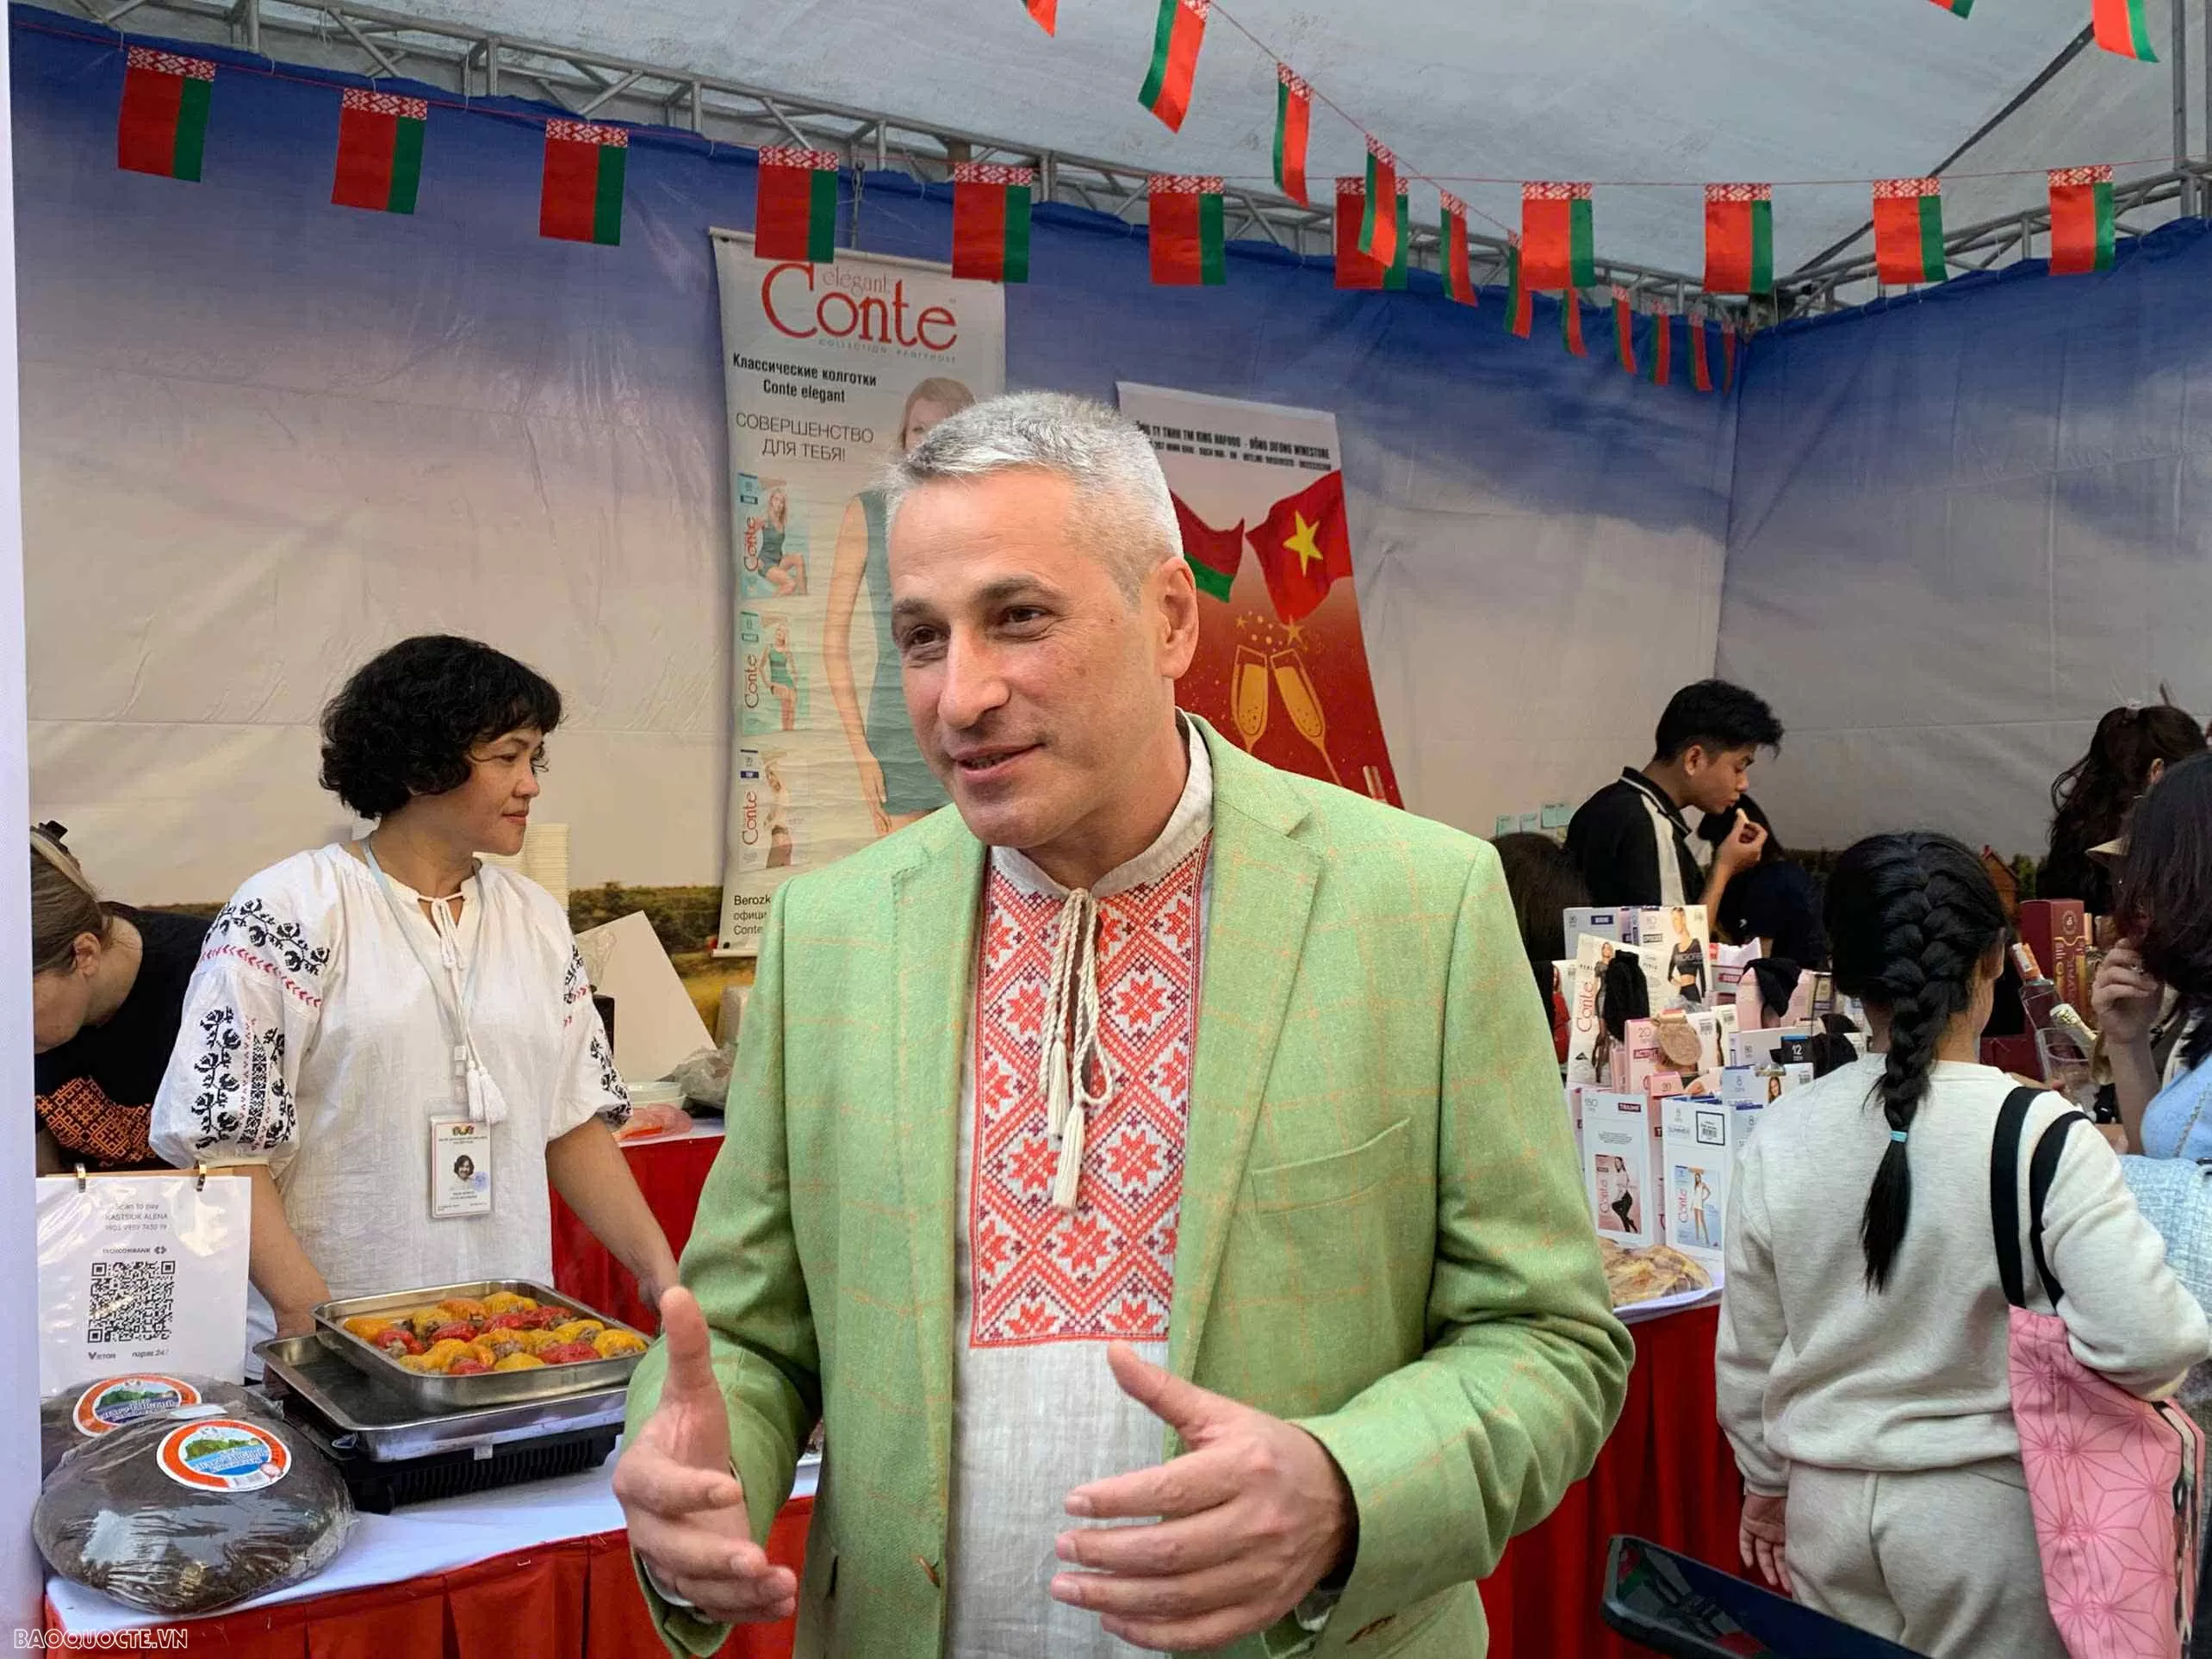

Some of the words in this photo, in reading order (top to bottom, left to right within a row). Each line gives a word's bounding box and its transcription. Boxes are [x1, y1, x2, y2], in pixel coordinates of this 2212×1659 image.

[761, 262, 958, 351] Conte
[733, 353, 818, 379] Классические
[823, 370, 877, 387] колготки
[763, 379, 798, 398] Conte
[801, 385, 845, 404] elegant
[736, 412, 874, 444] СОВЕРШЕНСТВО
[761, 438, 796, 457] ДЛЯ
[801, 443, 846, 463] ТЕБЯ!
[744, 654, 759, 708] Conte
[742, 791, 759, 845] Conte
[734, 895, 772, 905] Berozk
[1576, 981, 1594, 1032] Conte
[1792, 1044, 1802, 1055] 12
